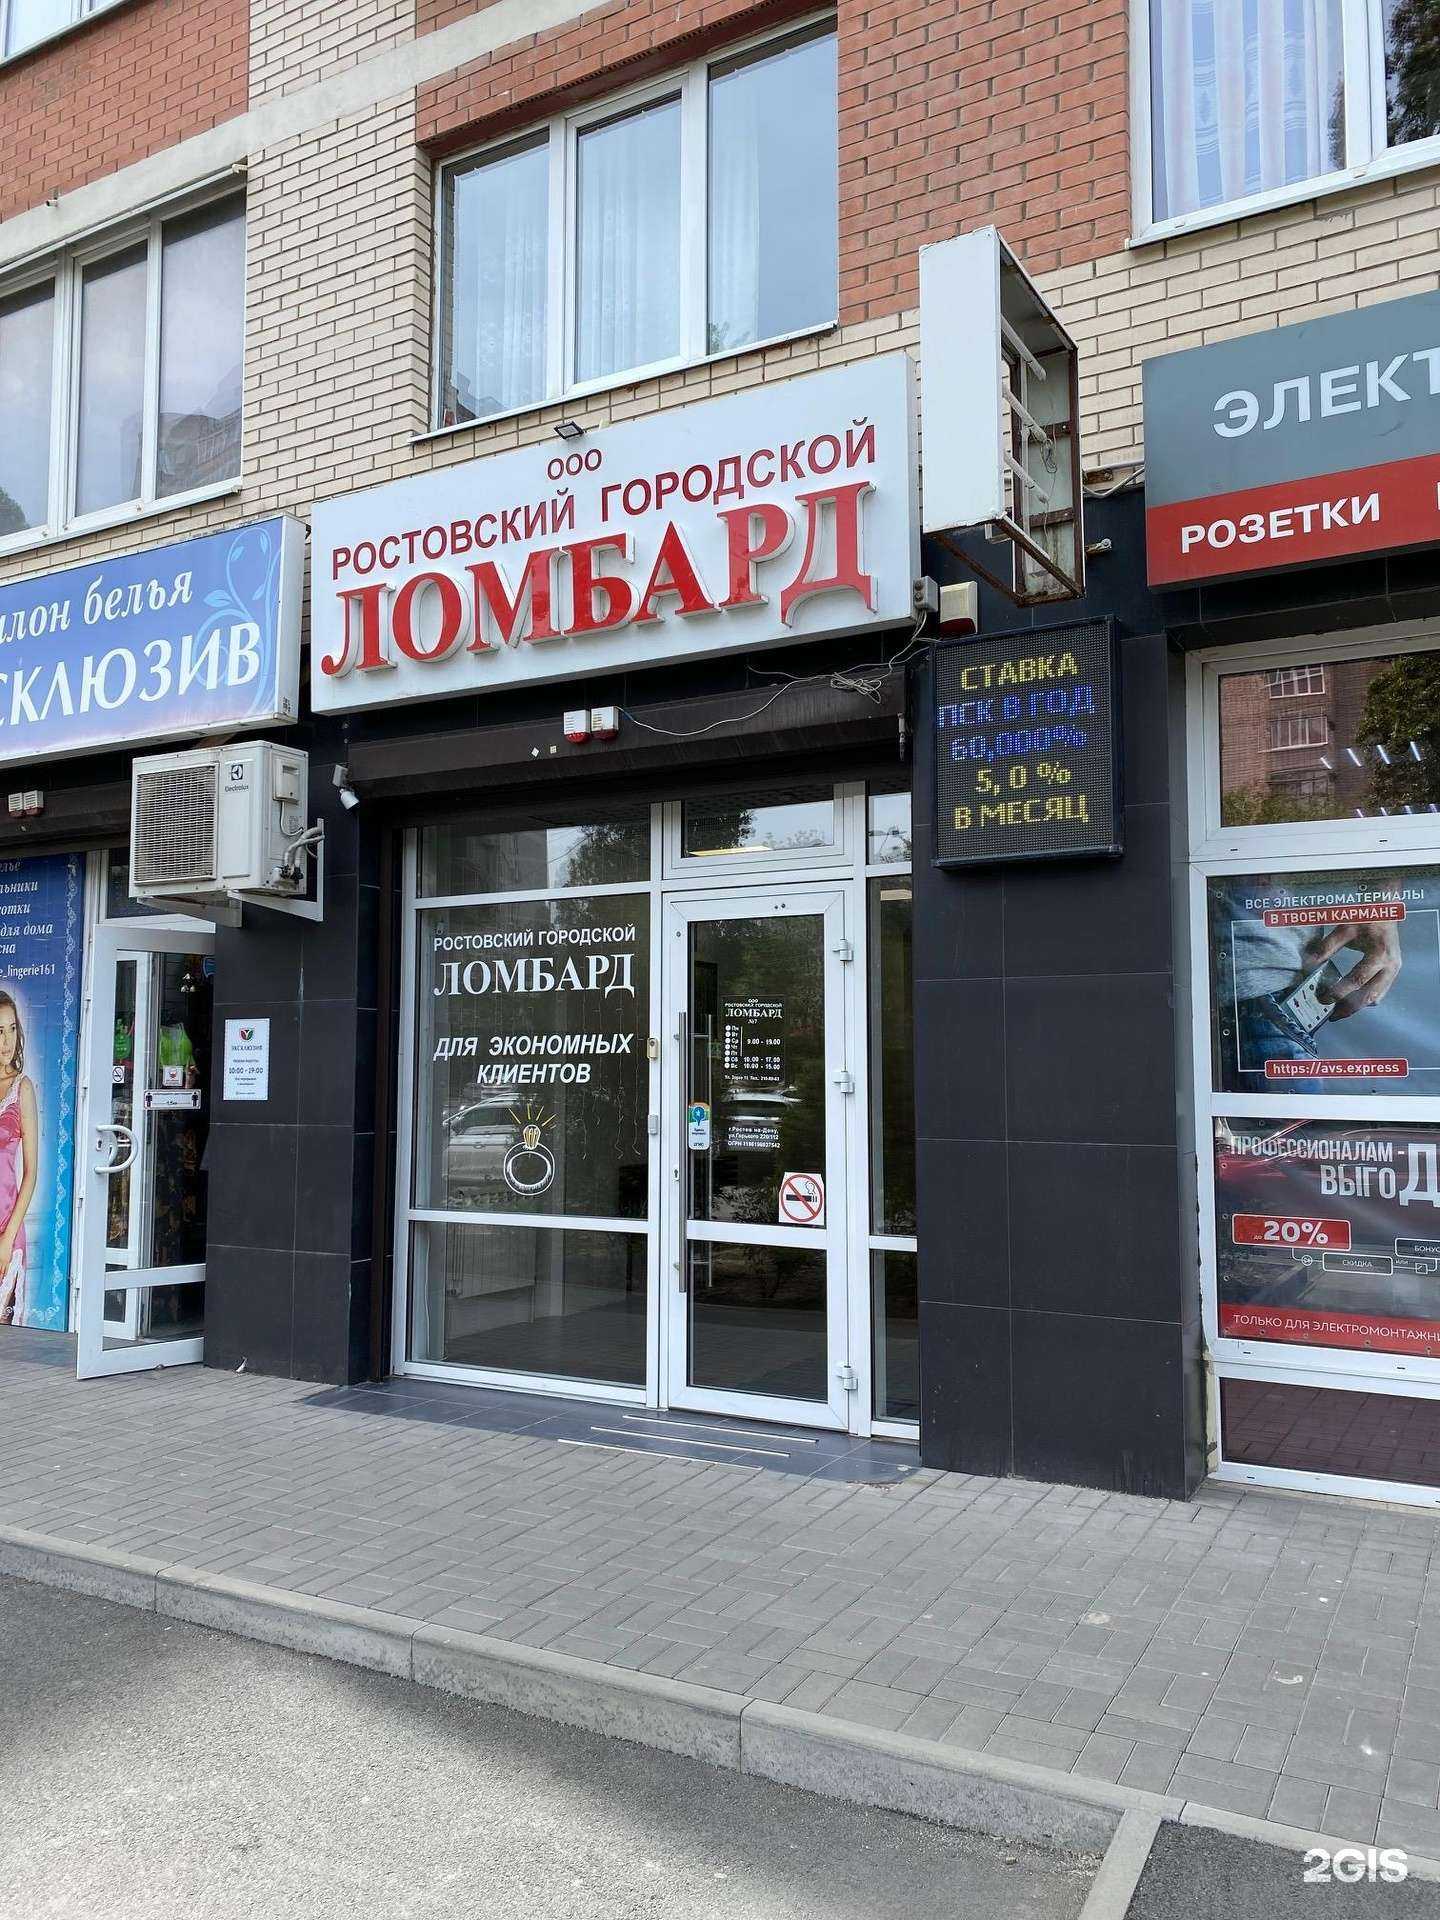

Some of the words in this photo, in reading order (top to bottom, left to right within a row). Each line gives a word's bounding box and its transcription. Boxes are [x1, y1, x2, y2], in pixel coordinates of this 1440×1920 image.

[547, 448, 602, 480] ООО
[332, 487, 575, 580] РОСТОВСКИЙ
[601, 416, 876, 523] ГОРОДСКОЙ
[1181, 493, 1380, 554] РОЗЕТКИ
[321, 480, 878, 678] ЛОМБАРД
[83, 571, 193, 625] белья
[961, 652, 1078, 690] СТАВКА
[937, 699, 994, 728] ПСК
[1003, 695, 1020, 720] В
[1030, 685, 1095, 717] ГОД
[954, 806, 972, 830] В
[980, 795, 1089, 827] МЕСЯЦ
[0, 903, 31, 916] отки
[1245, 898, 1270, 910] ВСЕ
[1273, 889, 1424, 909] ЭЛЕКТРОМАТЕРИАЛЫ
[1, 922, 20, 936] для
[24, 921, 53, 935] дома
[1270, 914, 1279, 924] В
[1282, 910, 1328, 924] ТВОЕМ
[1331, 906, 1398, 921] КАРМАНЕ
[434, 928, 533, 951] РОСТОВСКИЙ
[538, 924, 636, 946] ГОРОДСКОЙ
[433, 954, 635, 999] ЛОМБАРД
[725, 1008, 782, 1018] ЛОМБАРД
[433, 1037, 478, 1061] ДЛЯ
[488, 1033, 633, 1056] ЭКОНОМНЫХ
[477, 1063, 591, 1084] КЛИЕНТОВ
[1273, 1062, 1400, 1076] https://avs.express
[1263, 1220, 1329, 1245] 20%
[1342, 1259, 1373, 1268] СКИДКА
[1233, 1314, 1283, 1327] ТОЛЬКО
[1285, 1318, 1310, 1331] ДЛЯ
